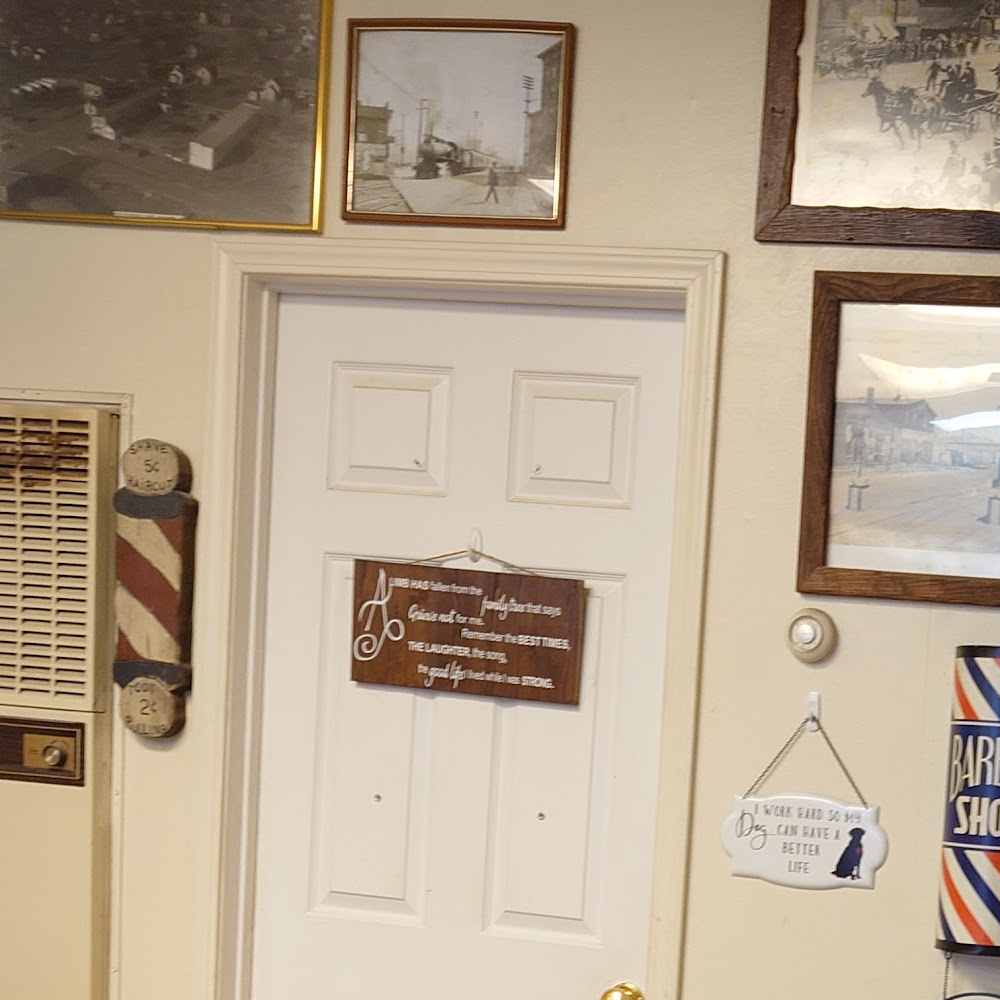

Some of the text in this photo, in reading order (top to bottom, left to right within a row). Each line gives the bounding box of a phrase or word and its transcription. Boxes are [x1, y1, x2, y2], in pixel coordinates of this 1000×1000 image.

[410, 580, 430, 590] HAS
[450, 583, 468, 594] from
[468, 586, 483, 596] the
[438, 609, 456, 624] not
[455, 613, 468, 624] for
[480, 594, 508, 621] family
[526, 602, 542, 615] that
[542, 606, 562, 618] says
[461, 628, 504, 642] Remember
[504, 633, 517, 644] the
[517, 634, 541, 647] BEST
[407, 641, 425, 652] THE
[471, 647, 485, 659] the
[417, 663, 429, 674] the
[424, 663, 450, 687] good
[754, 803, 862, 824] I WORK HARD SO MY
[735, 809, 841, 850] Dog CAN HAVE A
[781, 842, 820, 857] BETTER
[787, 860, 810, 874] LIFE
